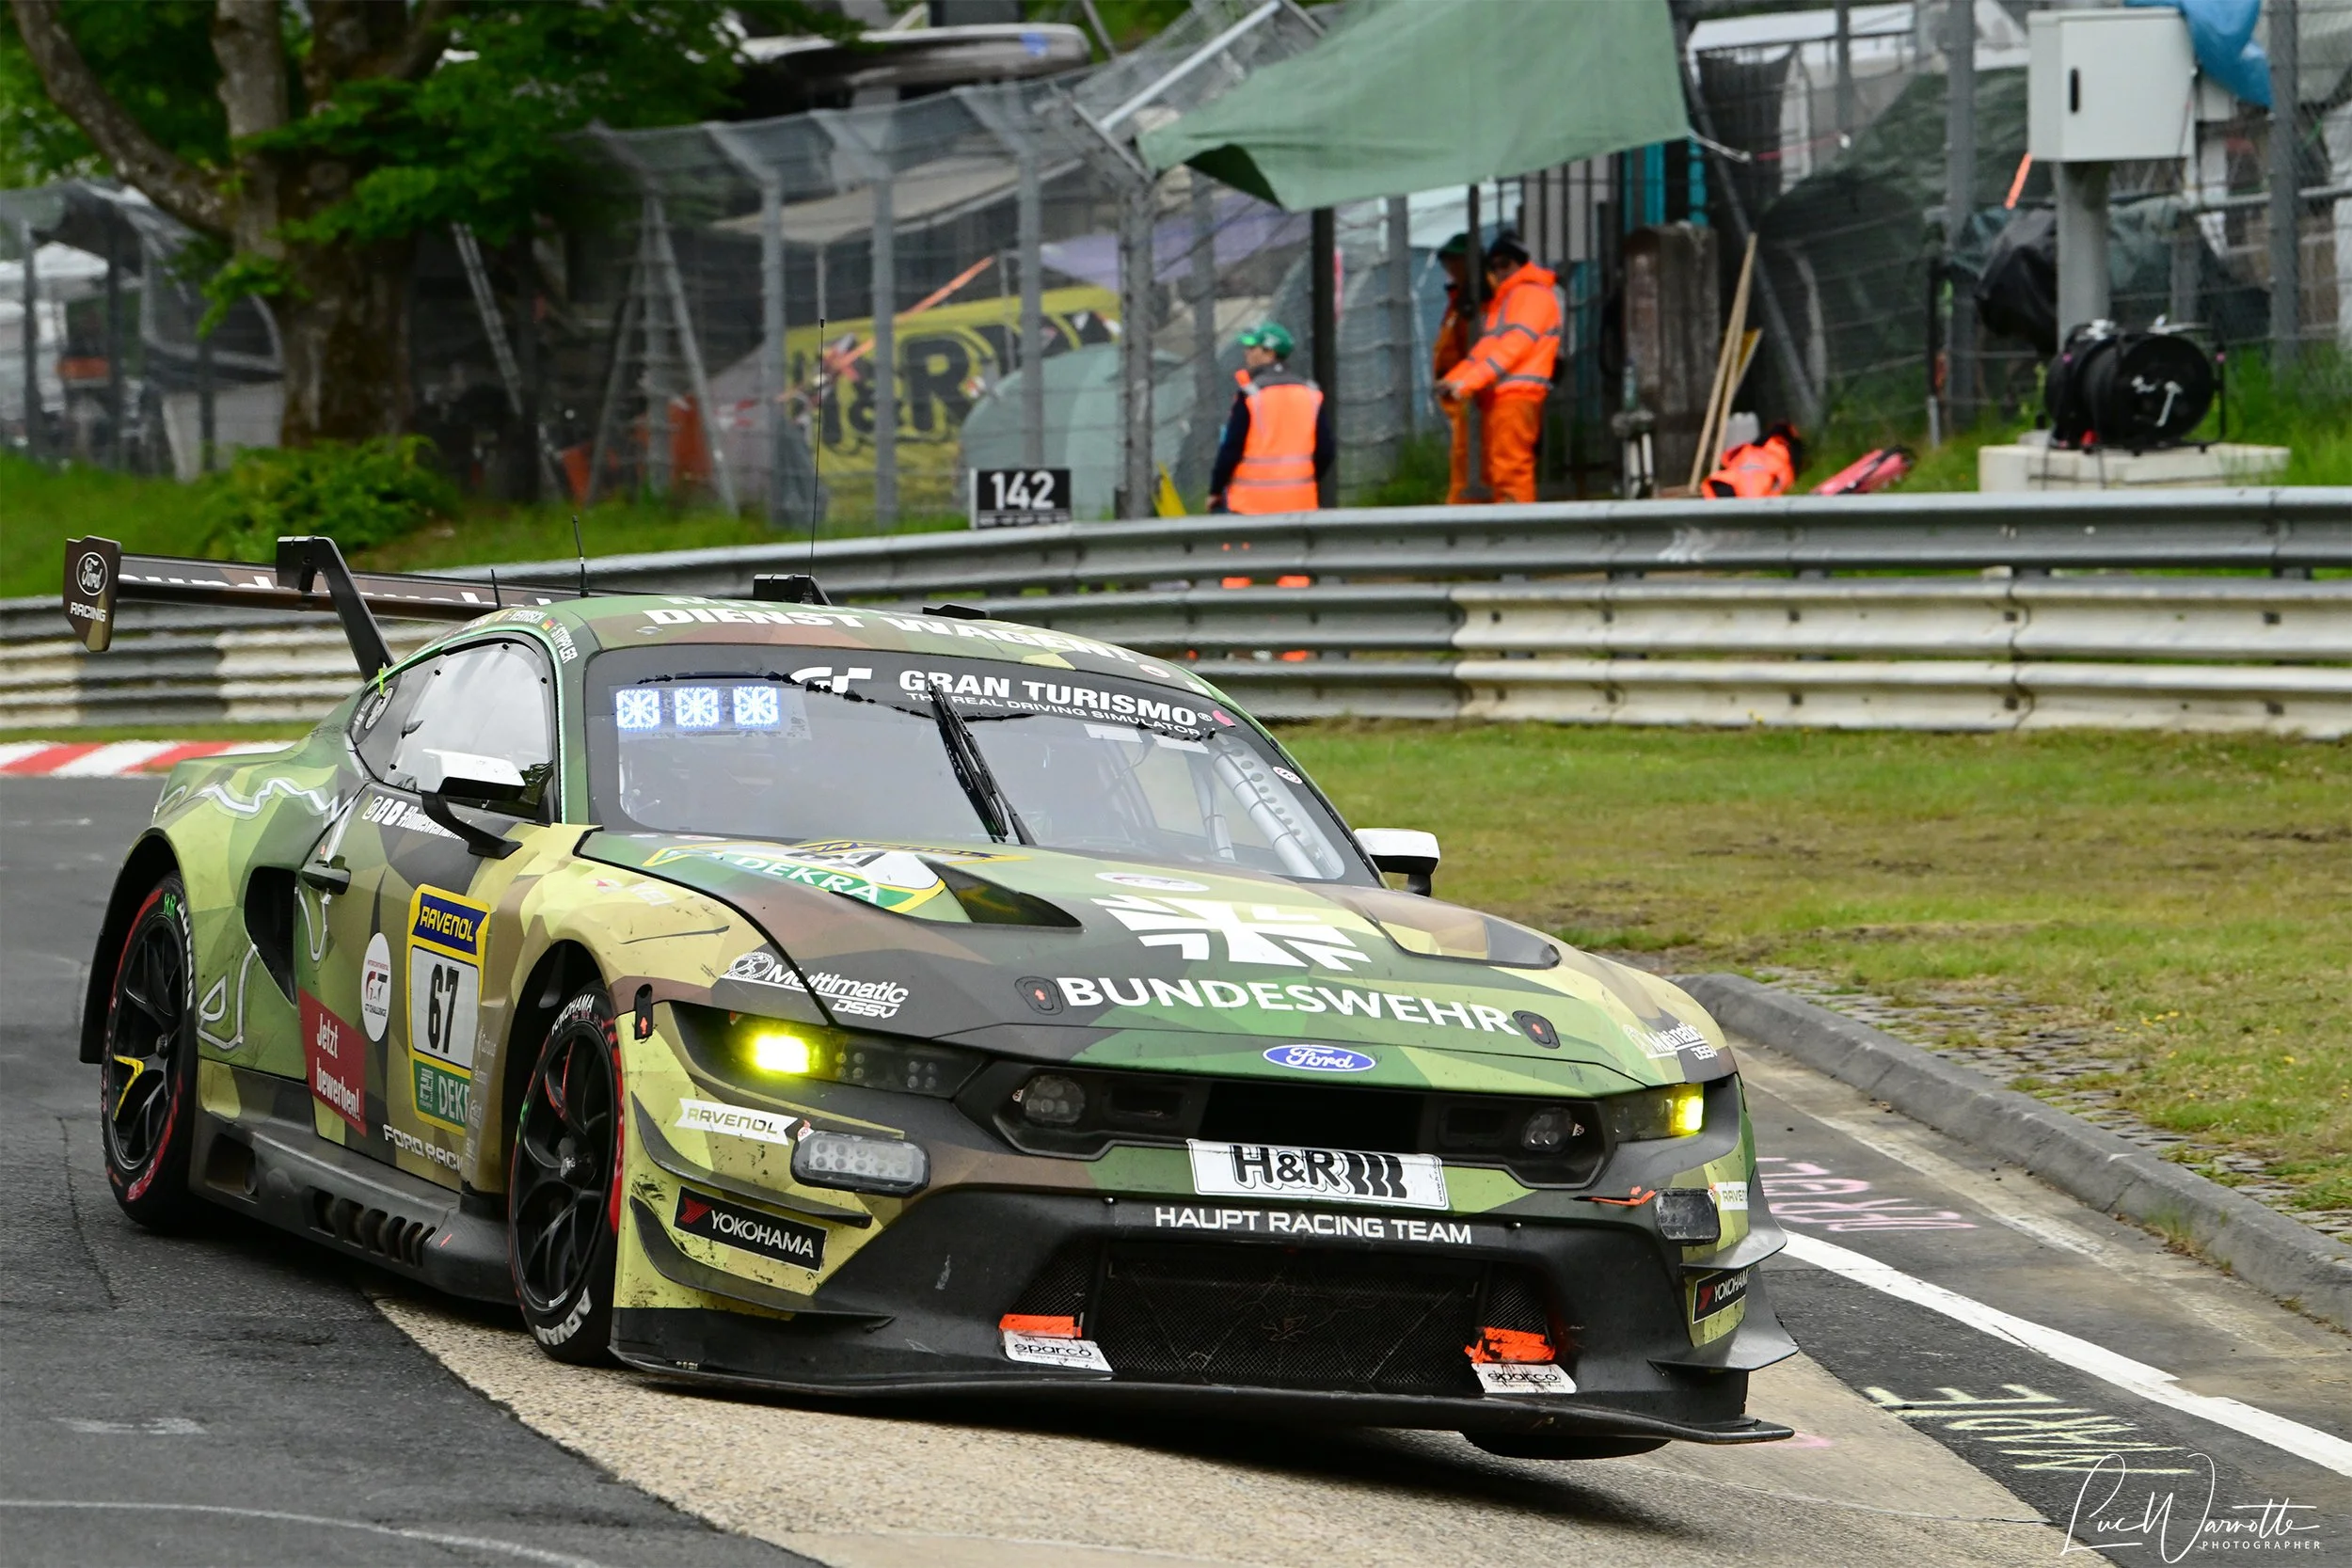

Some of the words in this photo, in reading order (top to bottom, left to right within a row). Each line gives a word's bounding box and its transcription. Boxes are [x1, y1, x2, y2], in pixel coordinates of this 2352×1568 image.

[991, 470, 1055, 509] 142
[81, 557, 102, 589] Ford
[70, 601, 106, 623] RACING
[643, 608, 866, 628] DIENST
[880, 616, 1137, 663] WAGEN!
[899, 670, 1010, 699] GRAN
[905, 692, 945, 705] TH
[952, 696, 1004, 708] REAL
[1008, 700, 1088, 718] DRIVING
[1092, 710, 1201, 737] SIMULATOR
[738, 857, 882, 905] DEKRA
[420, 906, 474, 942] RAVENOL
[765, 964, 909, 1005] Multimatic
[428, 963, 460, 1054] 67
[832, 999, 898, 1019] DSSV
[1056, 976, 1522, 1036] BUNDESWEHR
[316, 1013, 338, 1059] Jetzt
[1284, 1045, 1356, 1070] Ford
[316, 1057, 361, 1122] bewerben!
[383, 1124, 424, 1157] FORD
[687, 1107, 778, 1134] RAVENOL
[1229, 1144, 1343, 1188] H&R
[710, 1210, 815, 1259] YOKOHAMA
[1155, 1206, 1260, 1230] HAUPT
[1269, 1212, 1385, 1239] RACING
[1391, 1219, 1471, 1244] TEAM
[1014, 1343, 1092, 1356] sparco
[1863, 1383, 2199, 1474] MARIE
